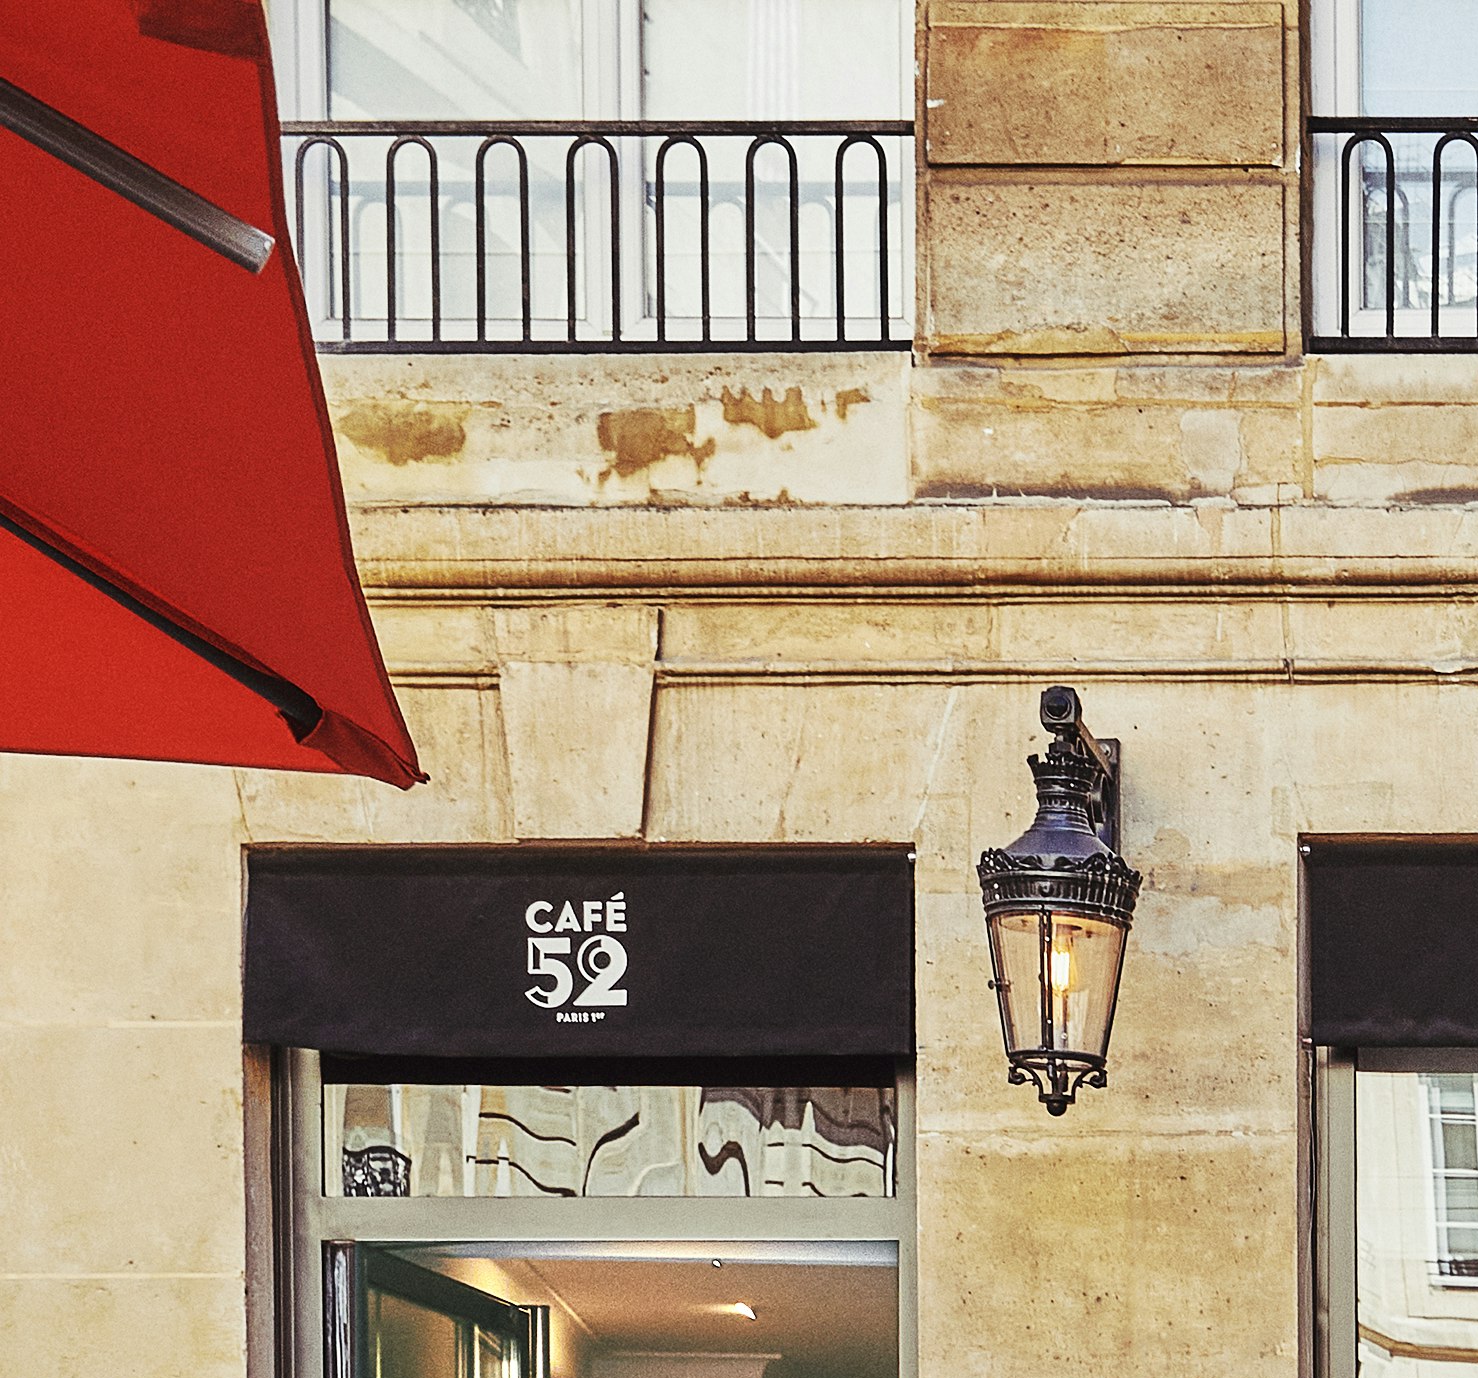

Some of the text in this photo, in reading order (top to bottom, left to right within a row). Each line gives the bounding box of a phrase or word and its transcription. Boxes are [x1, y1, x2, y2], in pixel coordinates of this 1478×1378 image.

[525, 891, 627, 933] CAFÉ
[525, 934, 628, 1009] 52
[556, 1012, 589, 1023] PARIS
